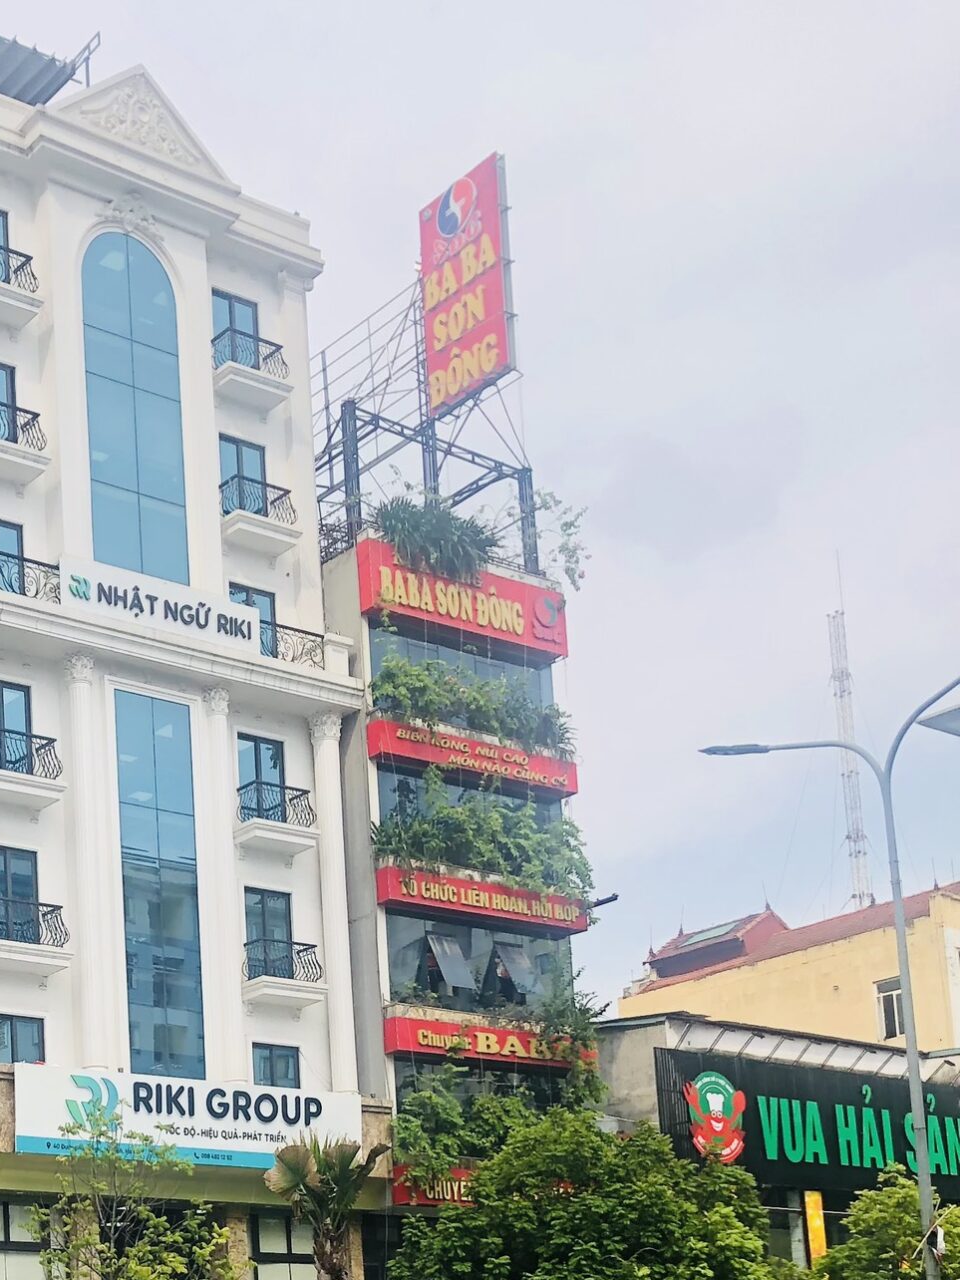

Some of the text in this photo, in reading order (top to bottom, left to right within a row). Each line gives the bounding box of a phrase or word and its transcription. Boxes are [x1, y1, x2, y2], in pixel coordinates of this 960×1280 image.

[97, 581, 252, 640] NHẬT NGỮ RIKI
[421, 879, 458, 904] CHỨC
[460, 886, 490, 909] LIÊN
[132, 1081, 323, 1127] RIKI GROUP
[757, 1095, 828, 1165] VUA
[835, 1084, 894, 1170] HẢI
[242, 1131, 262, 1142] PHÁT
